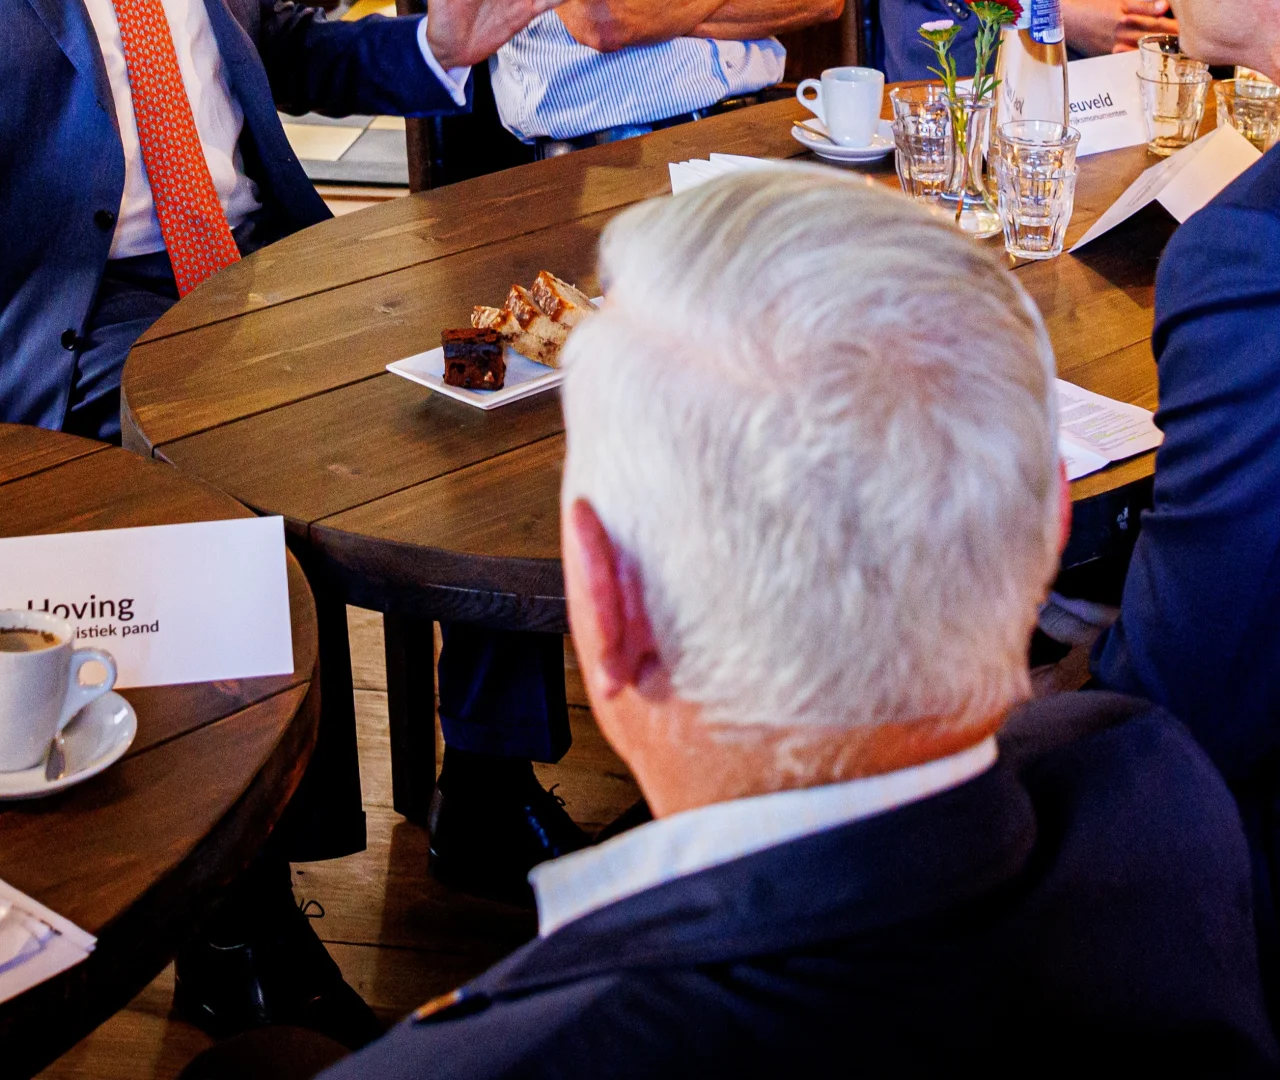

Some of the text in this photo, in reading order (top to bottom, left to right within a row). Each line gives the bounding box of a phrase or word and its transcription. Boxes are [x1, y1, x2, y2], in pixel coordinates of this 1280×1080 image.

[1068, 93, 1114, 113] euveld
[76, 620, 160, 640] istiek pand
